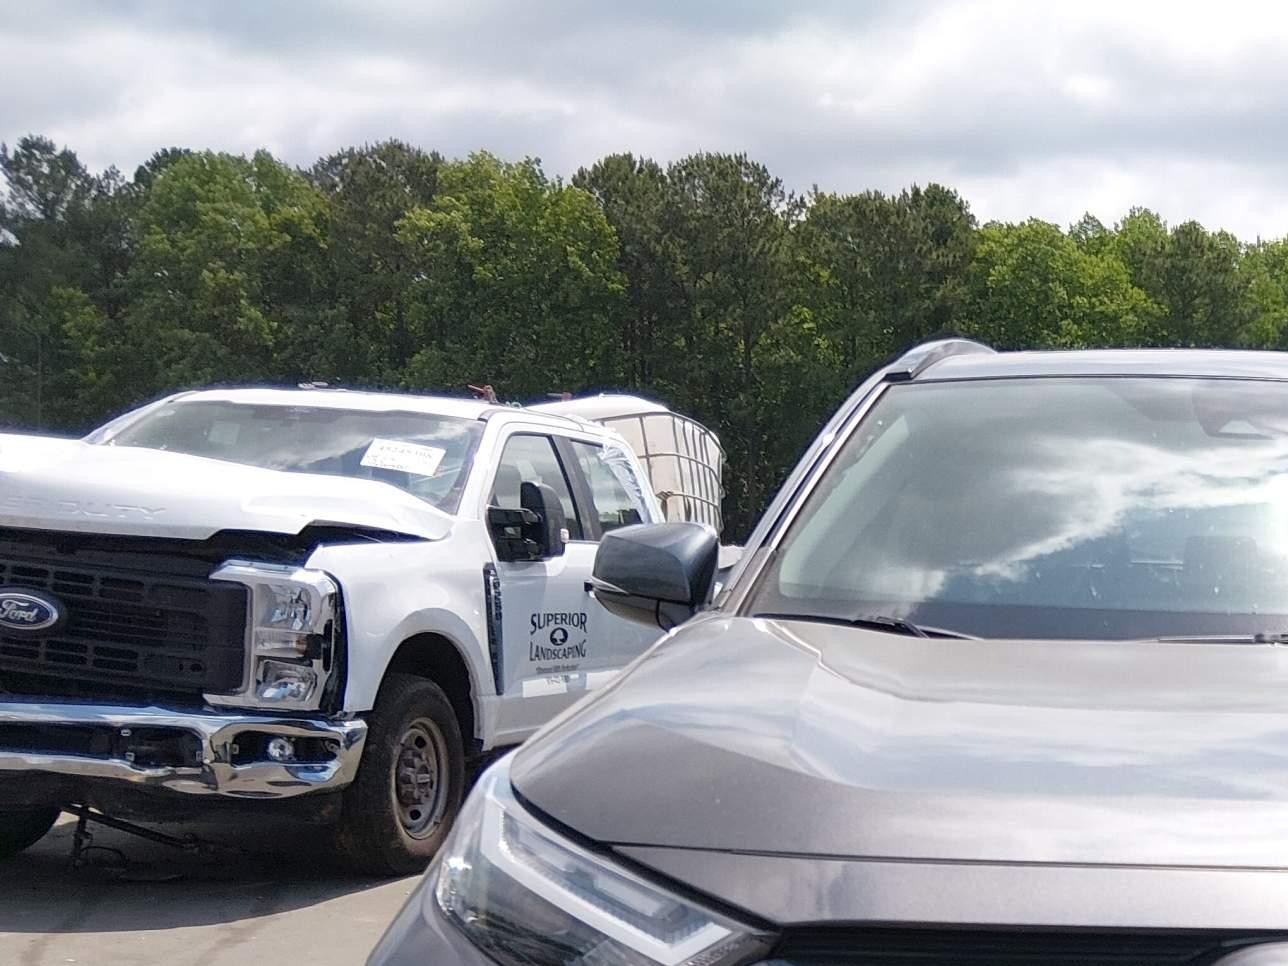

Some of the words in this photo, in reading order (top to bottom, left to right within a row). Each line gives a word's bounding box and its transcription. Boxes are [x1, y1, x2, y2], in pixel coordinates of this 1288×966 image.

[0, 600, 39, 623] Ford
[530, 612, 588, 636] SUPERIOR
[529, 639, 588, 662] LANDSCAPING
